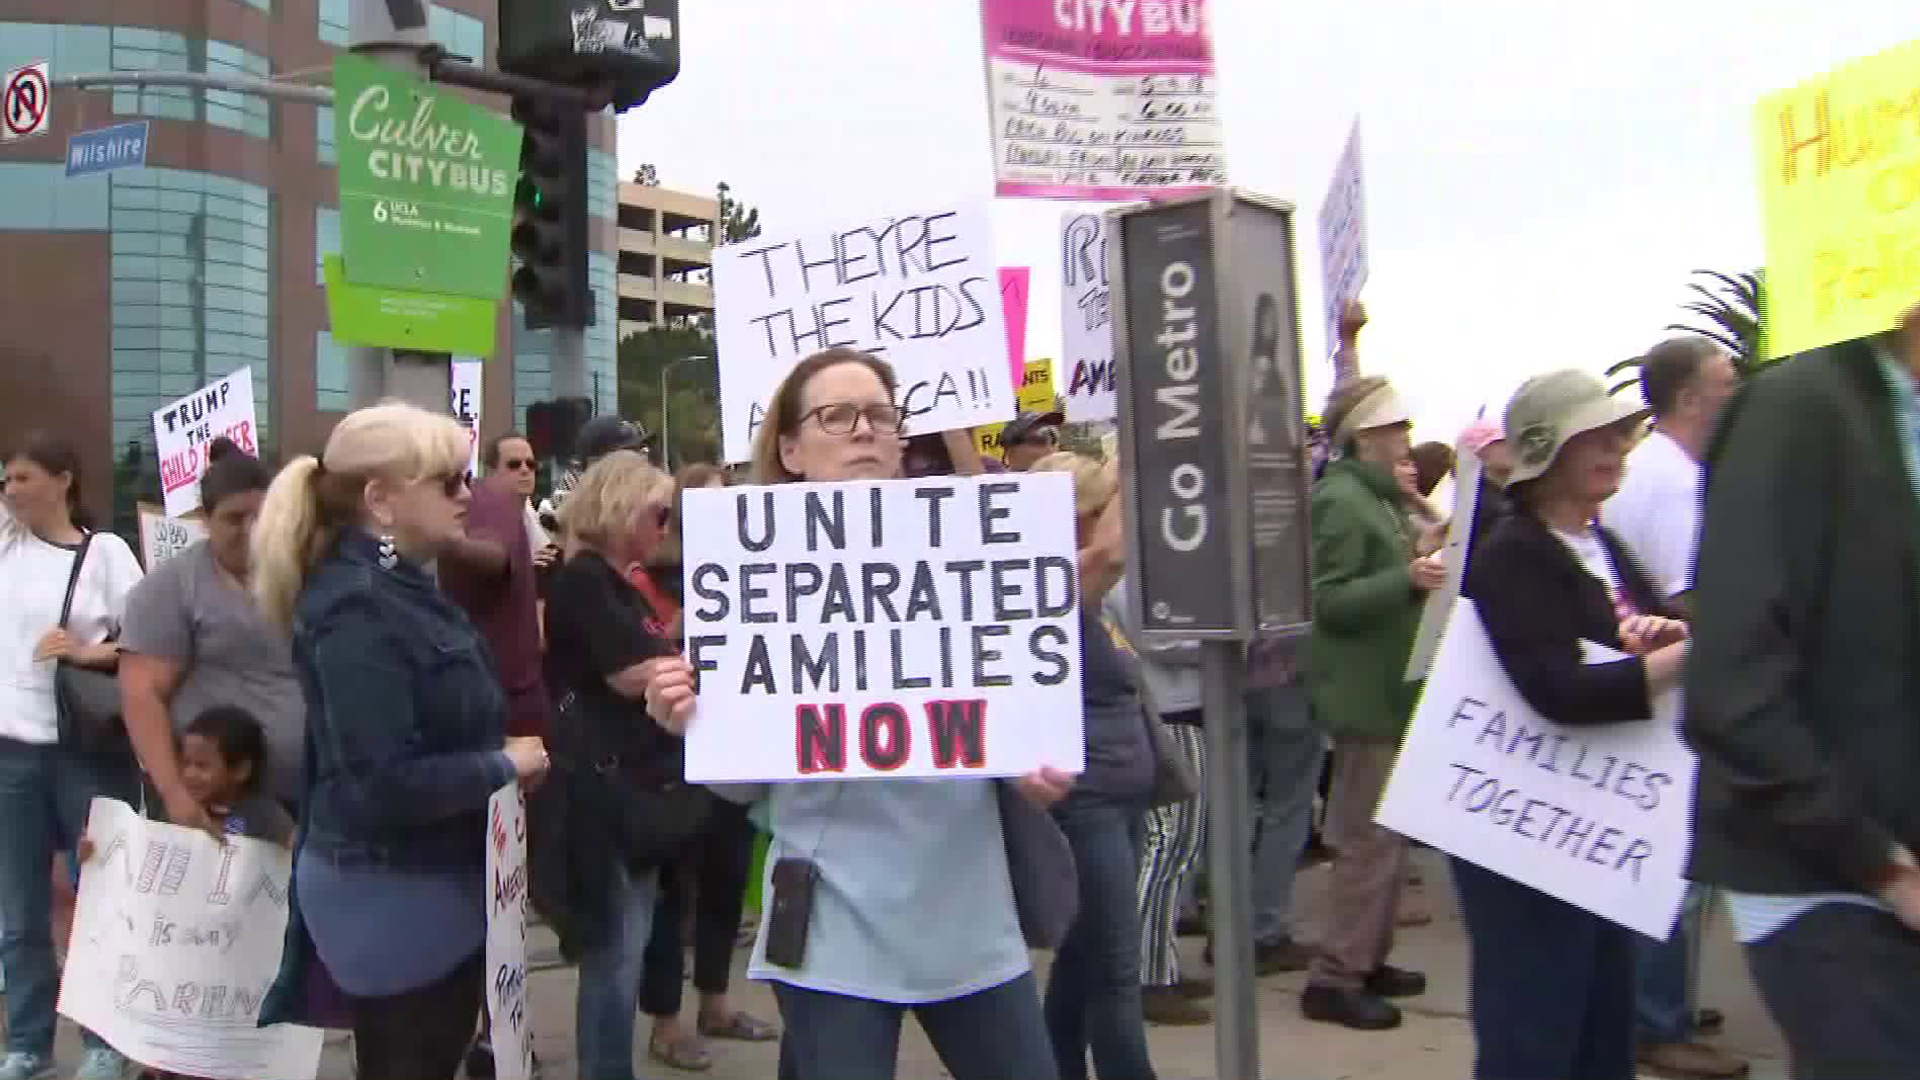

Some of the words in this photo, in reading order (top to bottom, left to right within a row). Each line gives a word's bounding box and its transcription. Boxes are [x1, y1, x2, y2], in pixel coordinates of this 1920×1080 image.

[72, 138, 142, 167] Wilshire
[350, 84, 483, 160] Culver
[368, 150, 508, 194] CITYBUS
[373, 202, 389, 222] 6
[750, 297, 858, 357] THE
[872, 276, 988, 341] KIDS
[1157, 262, 1202, 441] Metro
[163, 381, 230, 434] TRUMP
[186, 421, 211, 447] THE
[161, 446, 199, 489] CHILD
[736, 481, 1022, 552] UNITE
[1162, 463, 1208, 552] Go
[691, 556, 1076, 625] SEPARATED
[688, 624, 1071, 697] FAMILIES
[795, 699, 988, 774] NOW
[1447, 695, 1673, 811] FAMILIES
[1448, 762, 1653, 884] TOGETHER
